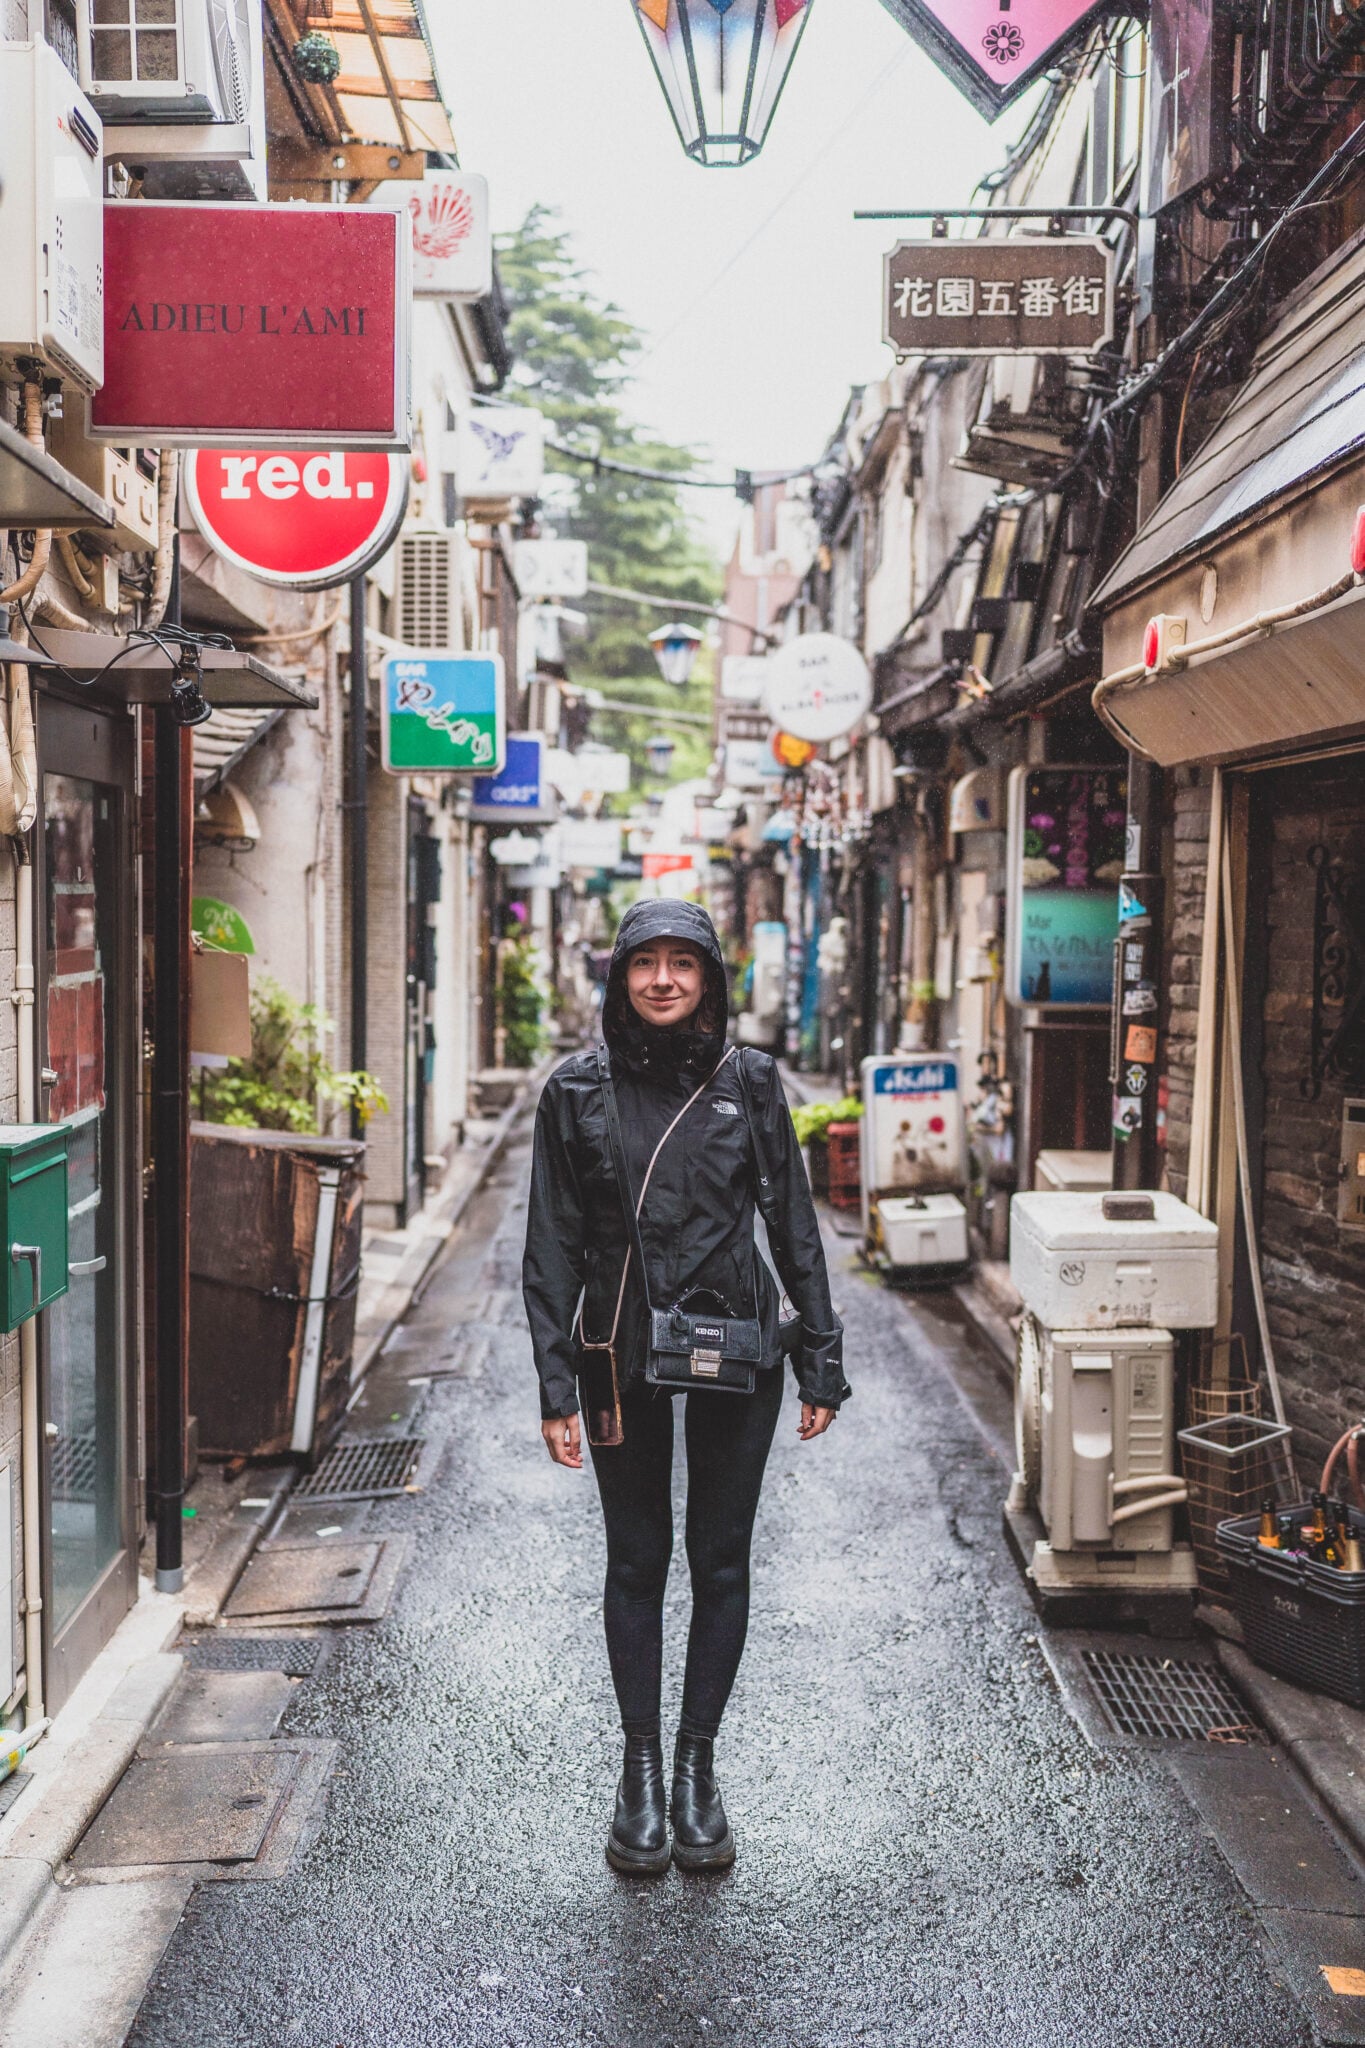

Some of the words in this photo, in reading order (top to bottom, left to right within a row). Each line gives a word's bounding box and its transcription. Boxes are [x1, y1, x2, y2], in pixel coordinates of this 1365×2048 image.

[893, 276, 1104, 318] 花園五番街
[119, 302, 245, 334] ADIEU
[258, 305, 369, 336] L'AMI
[220, 451, 374, 500] red.
[882, 1065, 945, 1092] Asahi
[695, 1327, 720, 1337] KENZO
